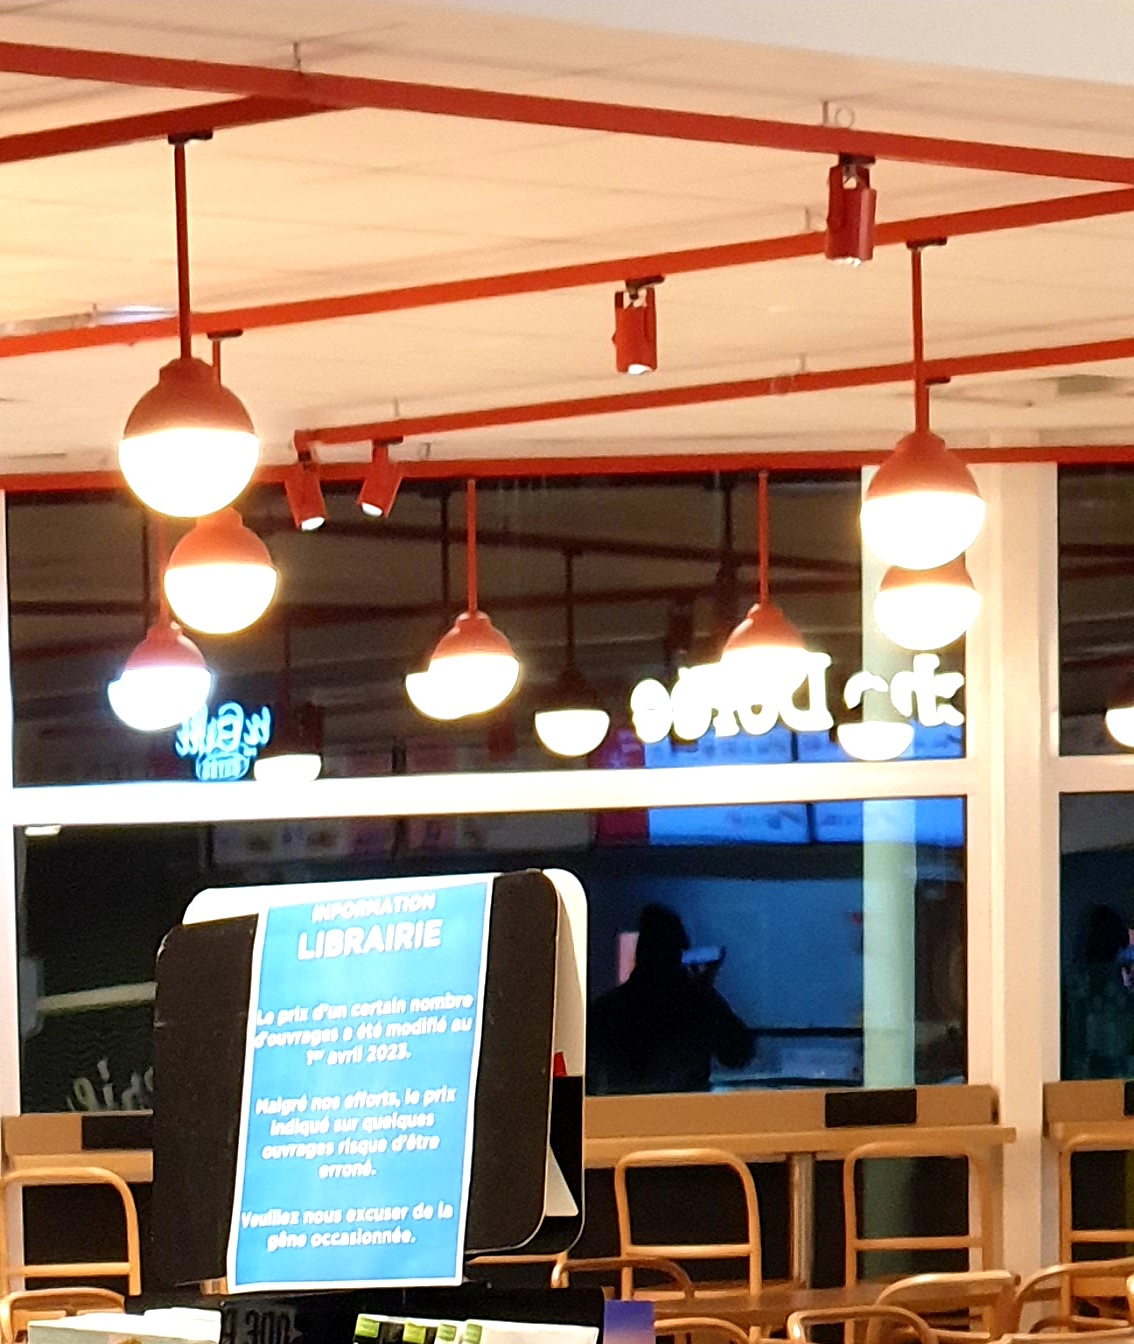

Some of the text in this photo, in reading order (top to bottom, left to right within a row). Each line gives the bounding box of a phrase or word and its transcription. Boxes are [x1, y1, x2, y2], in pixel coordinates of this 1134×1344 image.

[297, 918, 444, 961] LIBRAIRIE
[257, 991, 474, 1027] Le prix d'un certain nombre
[254, 1026, 339, 1049] d'ouvrages
[356, 1019, 383, 1041] été
[385, 1014, 448, 1038] modifié
[451, 1016, 473, 1032] au
[327, 1044, 363, 1066] avril
[366, 1041, 412, 1063] 2023.
[255, 1085, 457, 1117] Malgré nos efforts, le prix
[270, 1111, 435, 1137] indiqué sur quelques
[261, 1133, 441, 1160] ouvrages risque d'être
[241, 1200, 454, 1229] Veuillez nous excuser de la
[267, 1226, 417, 1252] gêne occasionnée.
